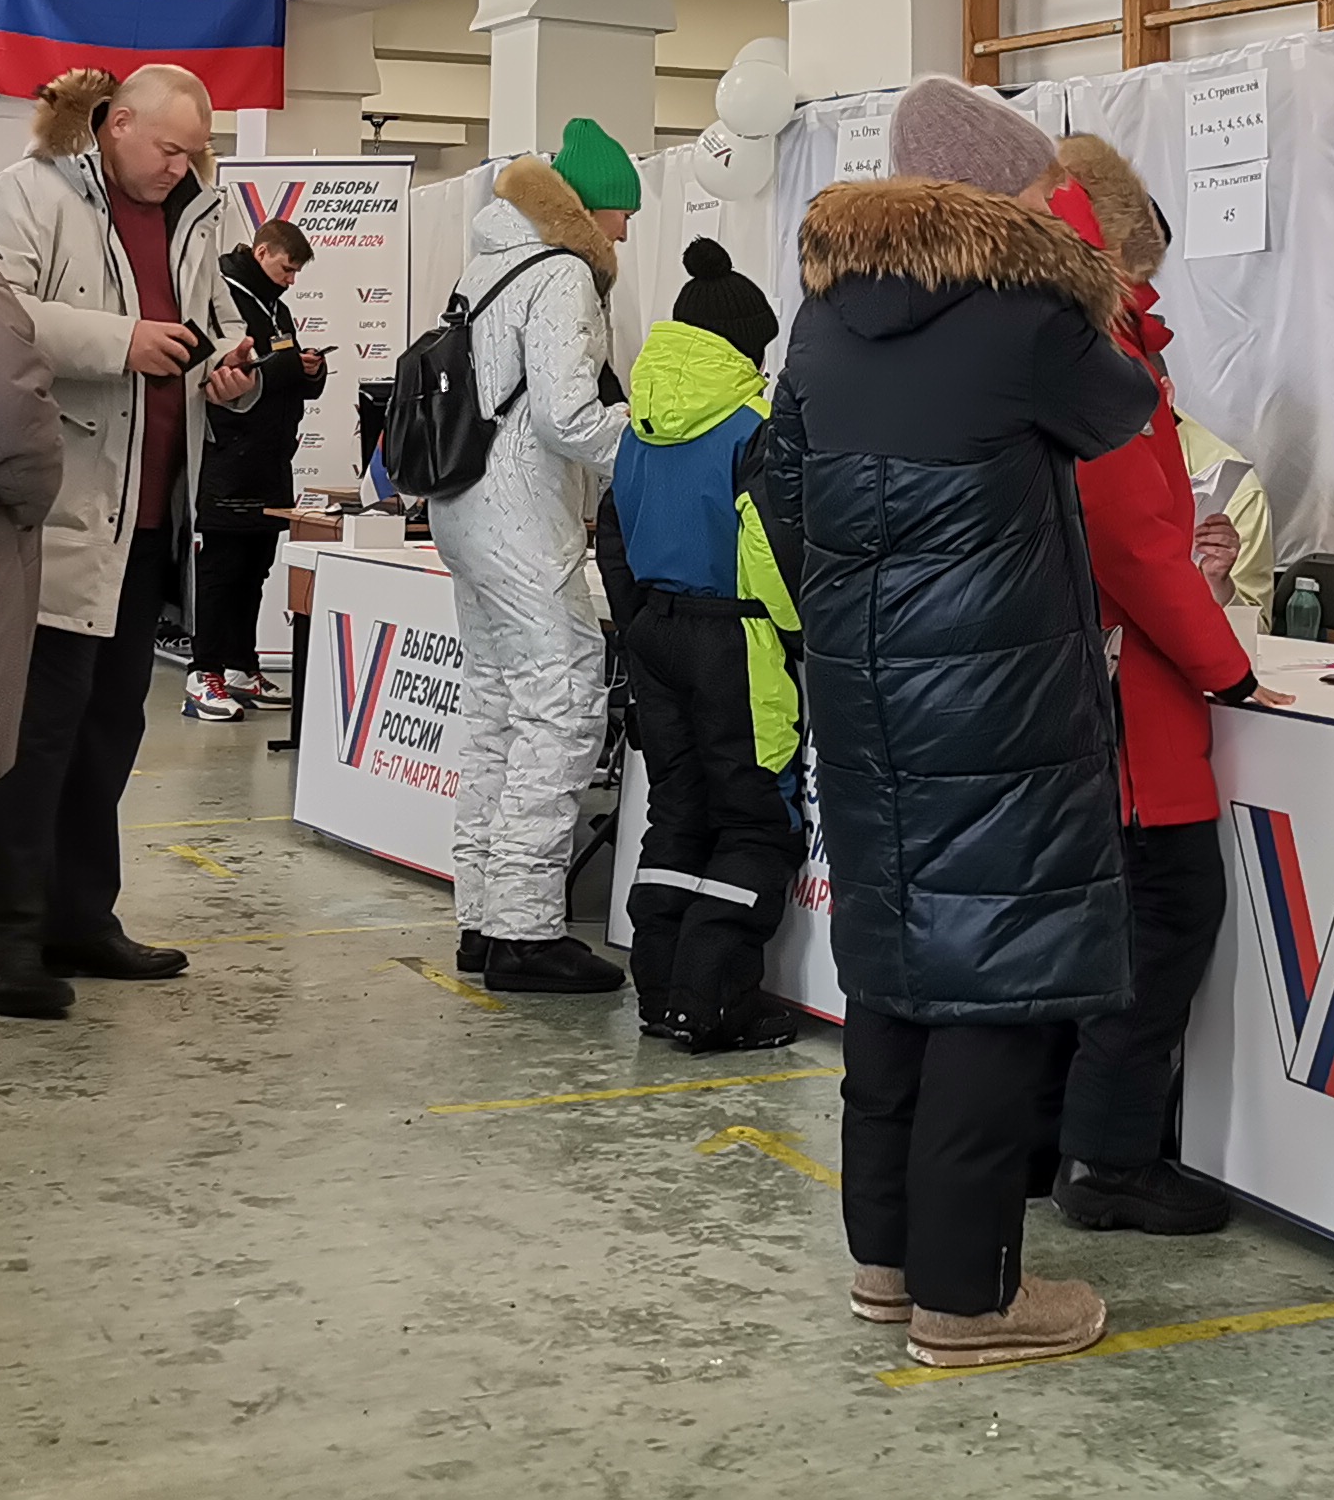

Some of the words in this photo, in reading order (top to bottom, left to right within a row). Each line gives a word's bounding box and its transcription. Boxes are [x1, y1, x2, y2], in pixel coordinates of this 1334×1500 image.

[1192, 93, 1206, 106] ул.
[1207, 79, 1260, 101] Строителей
[1223, 135, 1230, 146] 9
[312, 181, 380, 195] ВЫБОРЫ
[1192, 181, 1207, 192] ул.
[304, 199, 399, 215] ПРЕЗИДЕНТА
[1223, 207, 1236, 222] 45
[298, 217, 357, 231] РОССИИ
[320, 235, 357, 247] МАРТА
[358, 235, 385, 247] 2024
[389, 668, 463, 717] ПРЕЗИДЕ
[378, 709, 445, 754] РОССИИ
[400, 759, 442, 795] МАРТА
[441, 770, 460, 799] 20
[789, 874, 834, 916] МАР
